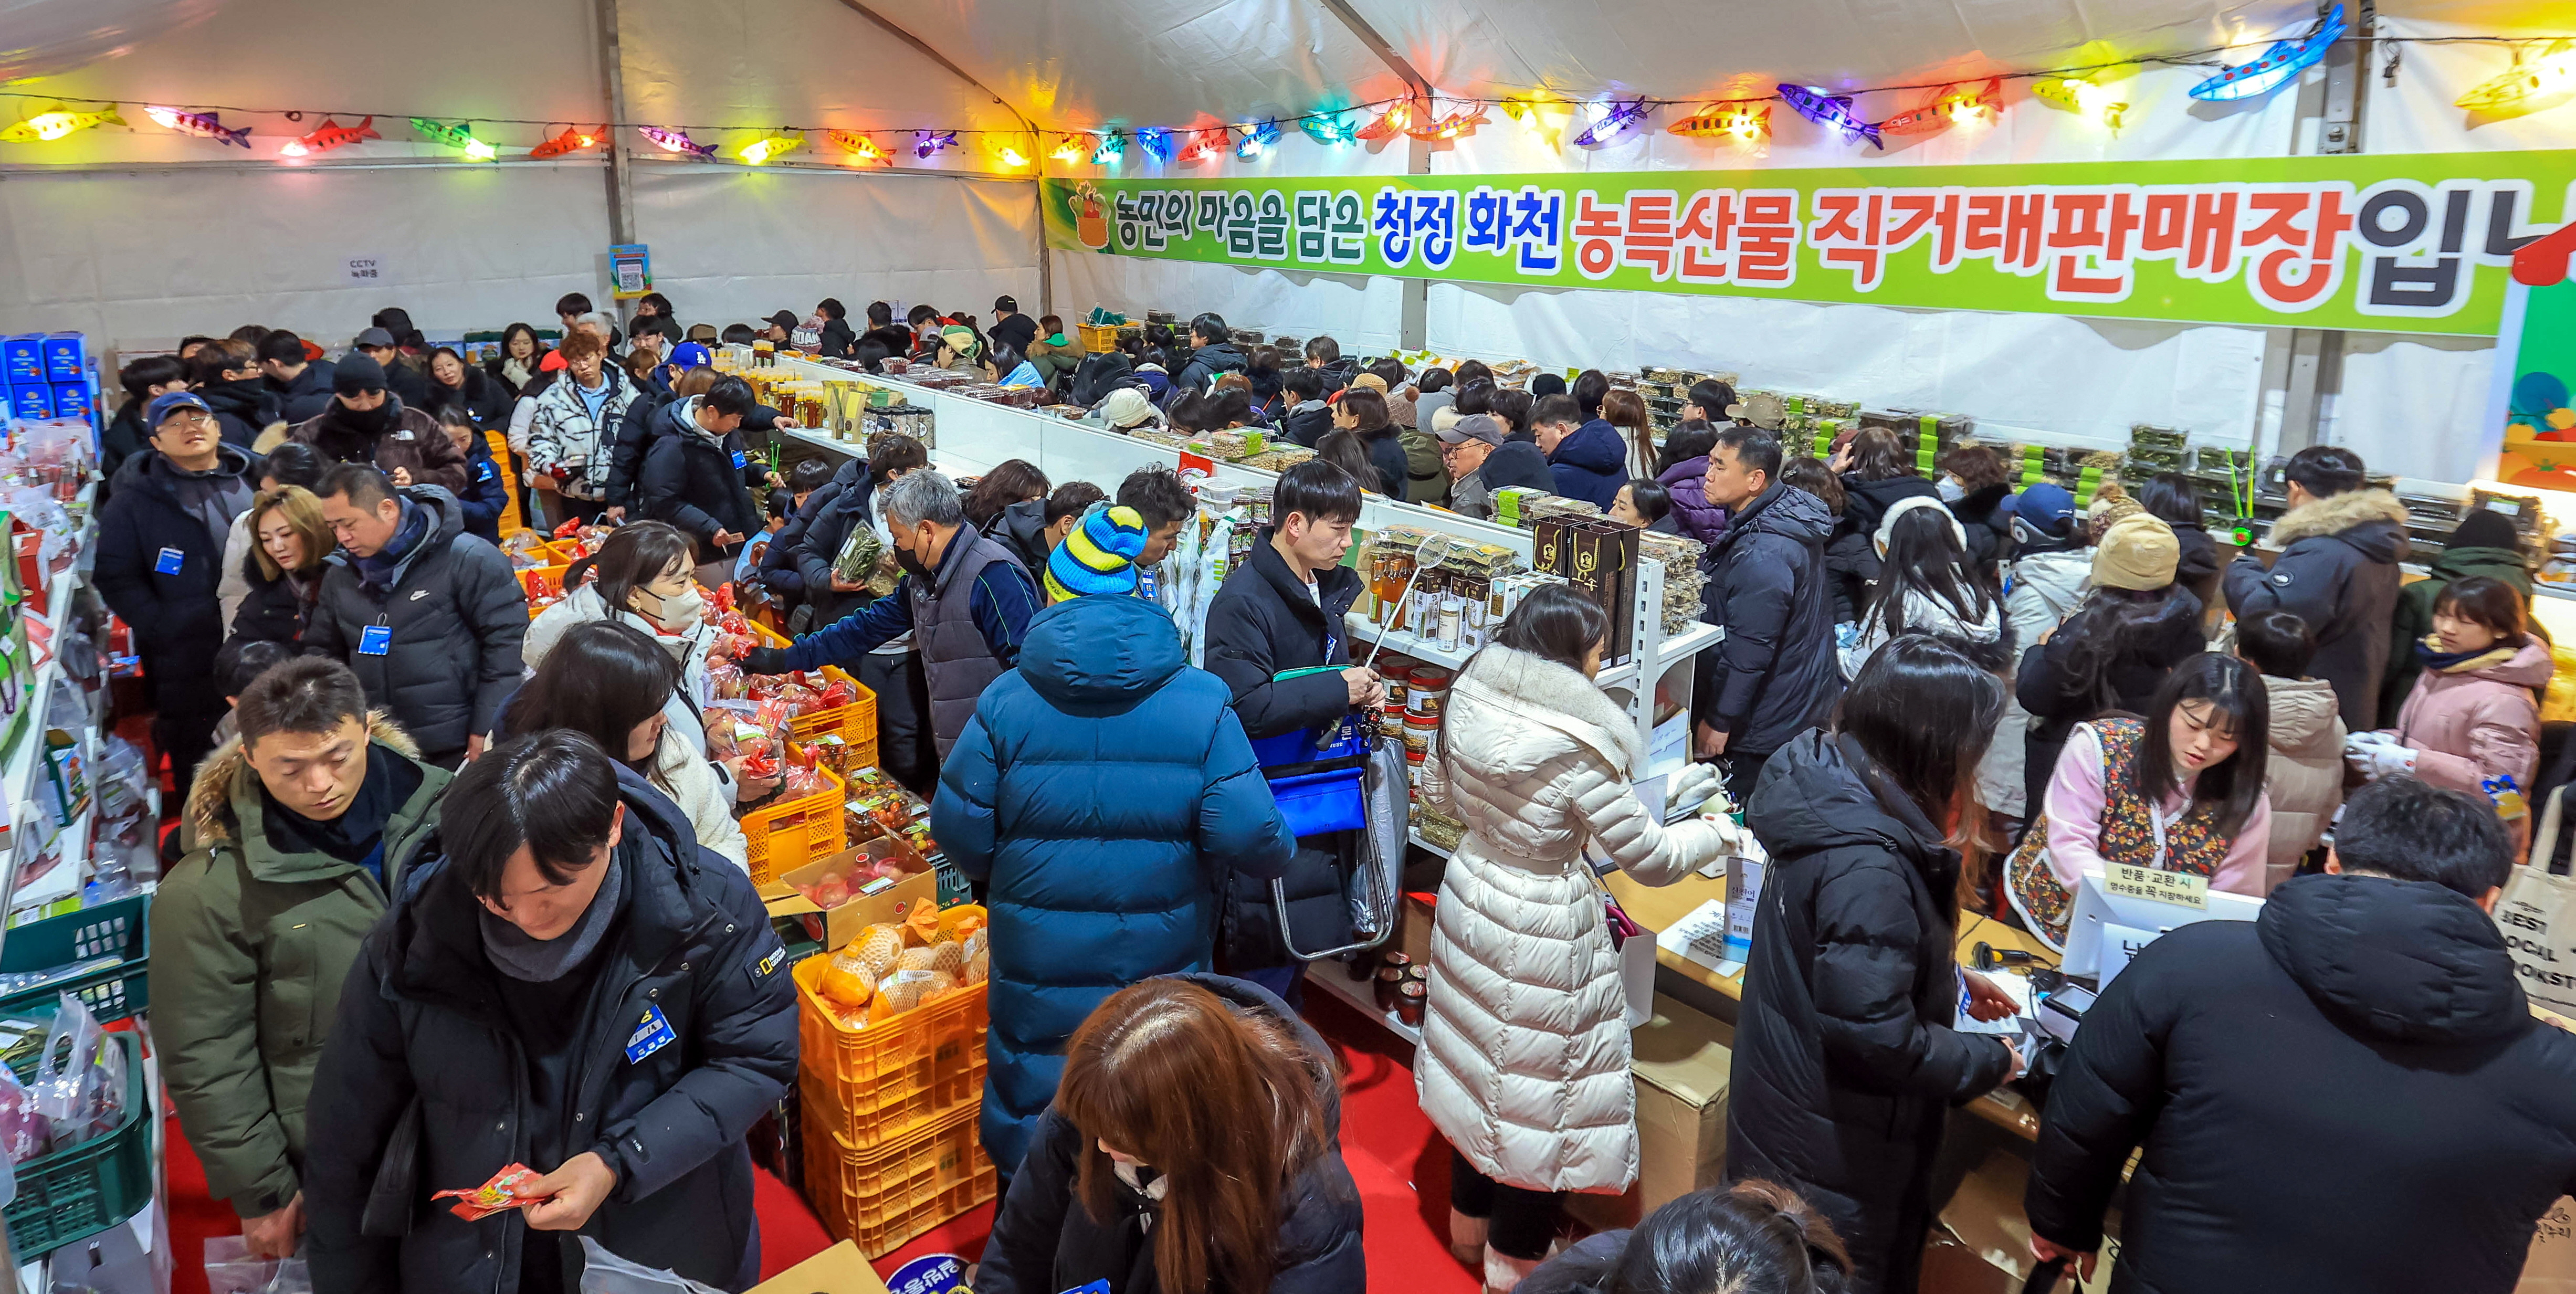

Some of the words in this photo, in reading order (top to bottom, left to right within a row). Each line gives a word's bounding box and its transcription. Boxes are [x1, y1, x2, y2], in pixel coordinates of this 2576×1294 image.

[1117, 194, 1191, 247] 농민의
[1198, 194, 1287, 255] 마음을
[1297, 194, 1365, 259] 담은
[1374, 192, 1455, 265] 청정
[1468, 191, 1558, 269] 화천
[1575, 195, 1795, 281] 농특산물
[2110, 882, 2143, 896] 영수증을
[2146, 885, 2157, 898] 꼭
[2122, 868, 2176, 887] 반품·교환
[2180, 878, 2191, 889] 시
[2507, 935, 2560, 963] OCAL
